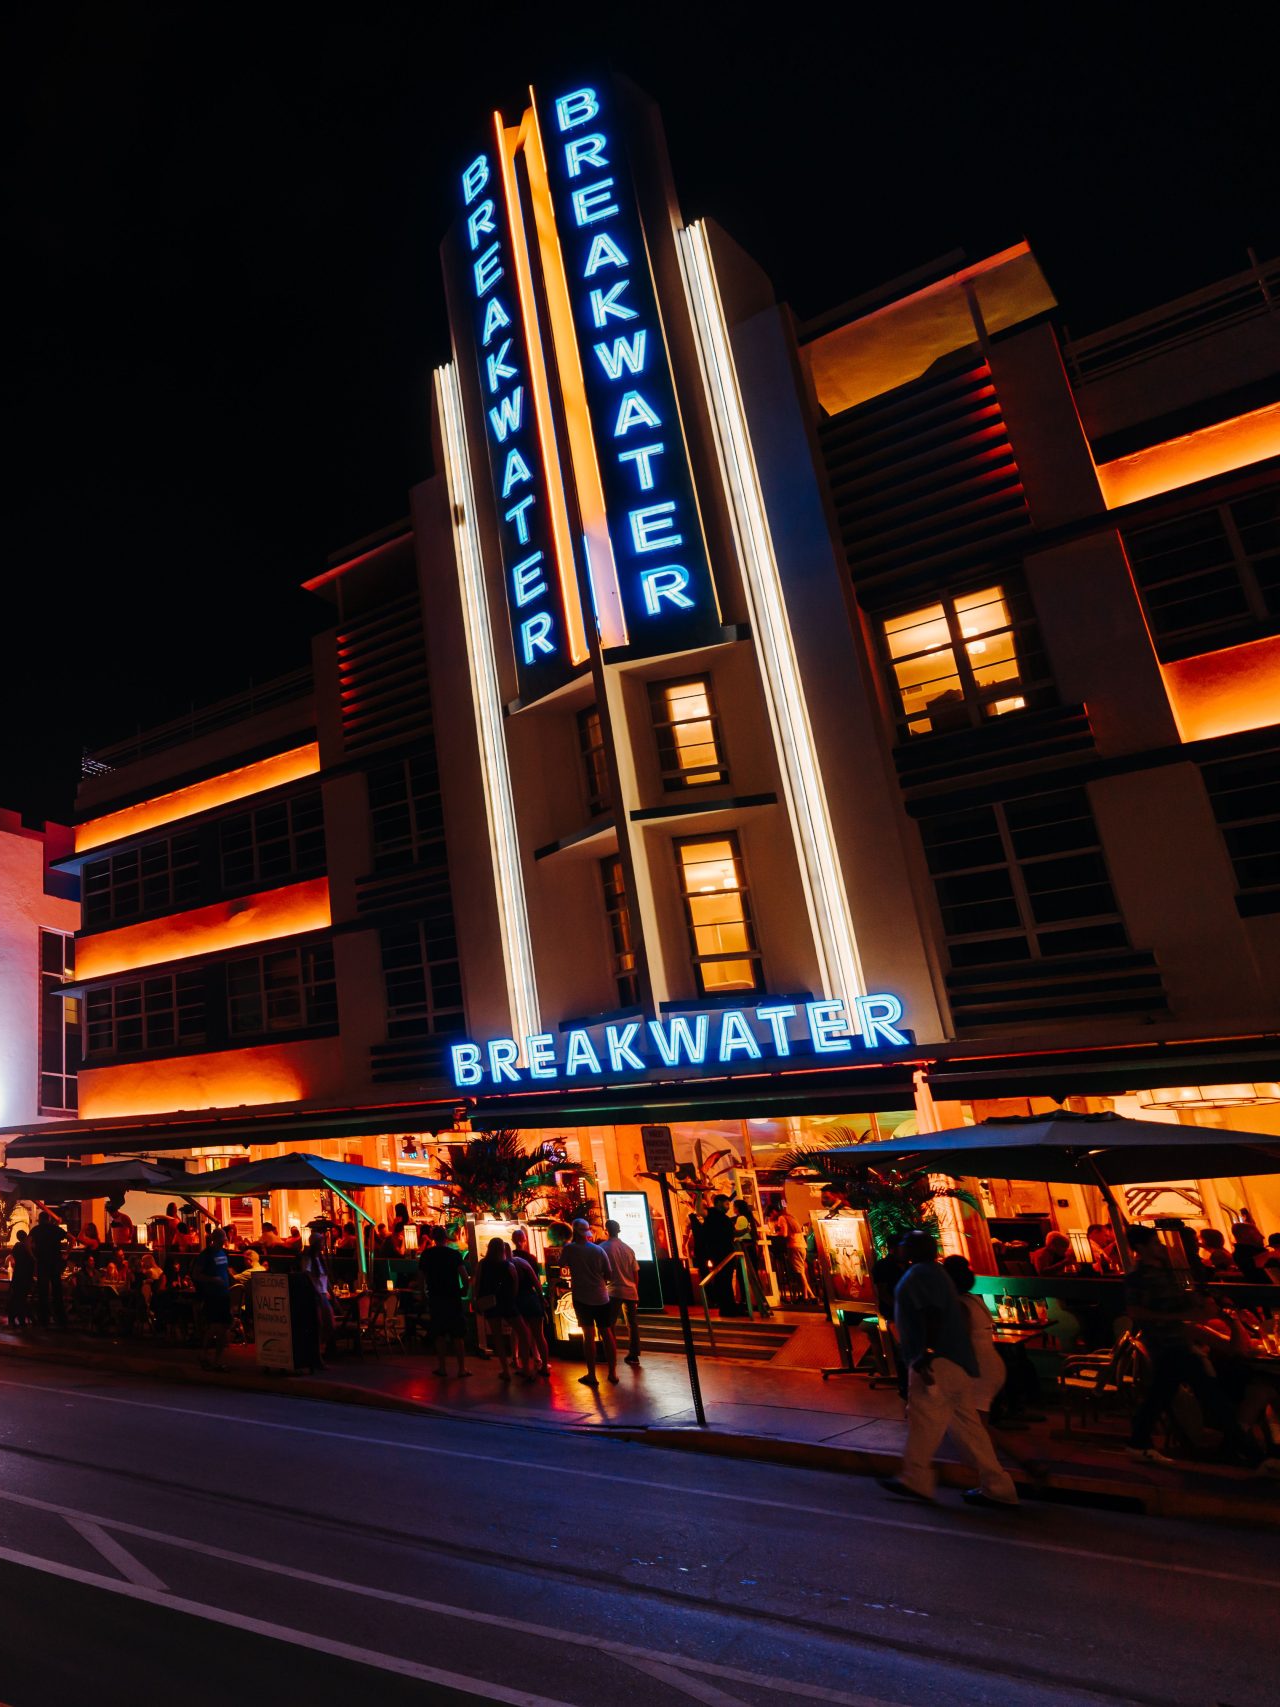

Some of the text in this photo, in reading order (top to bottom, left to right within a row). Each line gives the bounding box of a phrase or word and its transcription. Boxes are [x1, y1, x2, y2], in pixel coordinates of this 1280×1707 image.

[555, 87, 696, 616] BREAKWATER
[461, 154, 557, 665] BREAKWATER
[449, 993, 911, 1087] BREAKWATER
[256, 1296, 287, 1312] VALET
[257, 1313, 288, 1324] PARKING
